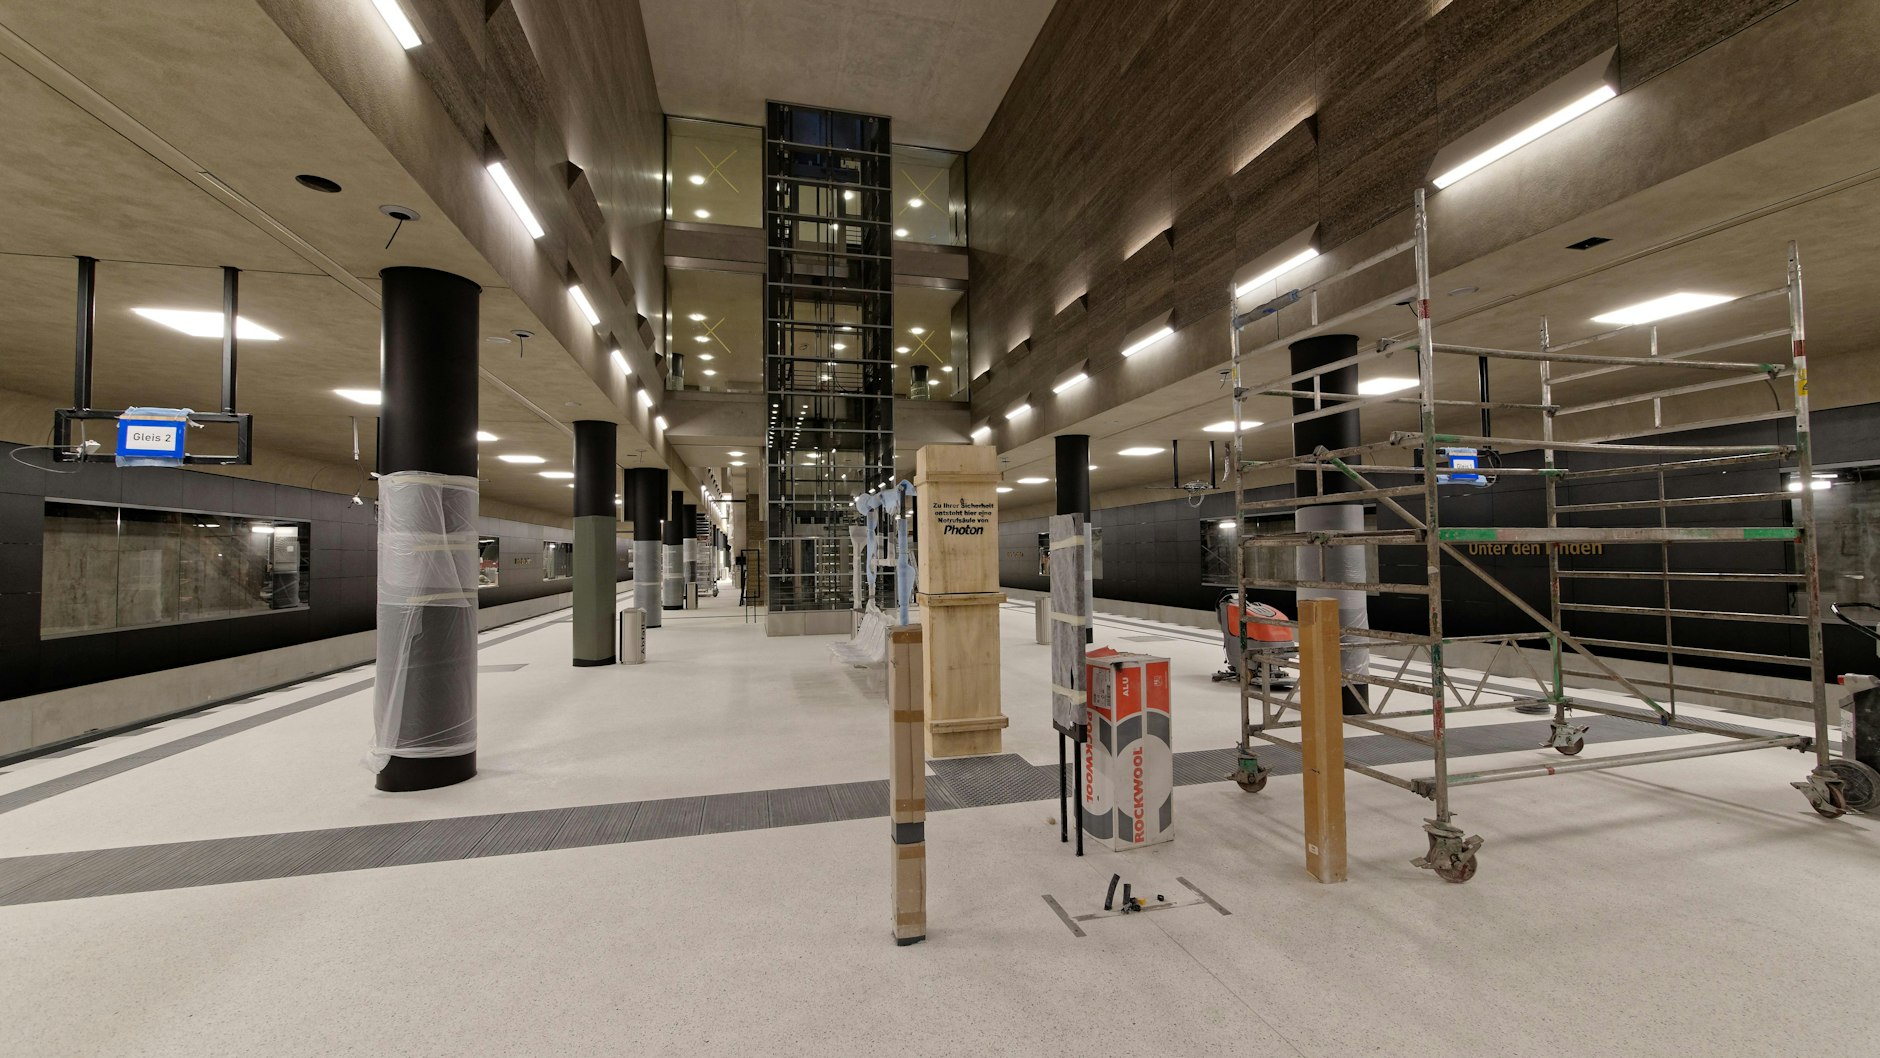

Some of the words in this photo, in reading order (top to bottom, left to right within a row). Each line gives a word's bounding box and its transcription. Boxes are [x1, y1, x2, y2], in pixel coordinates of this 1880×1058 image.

[133, 432, 161, 442] Gleis
[165, 434, 171, 442] 2
[943, 525, 984, 535] Photon
[1468, 543, 1508, 555] Unter
[1512, 543, 1541, 555] den
[1086, 711, 1094, 802] ROCKWOOL
[1133, 746, 1144, 844] ROCKWOOL
